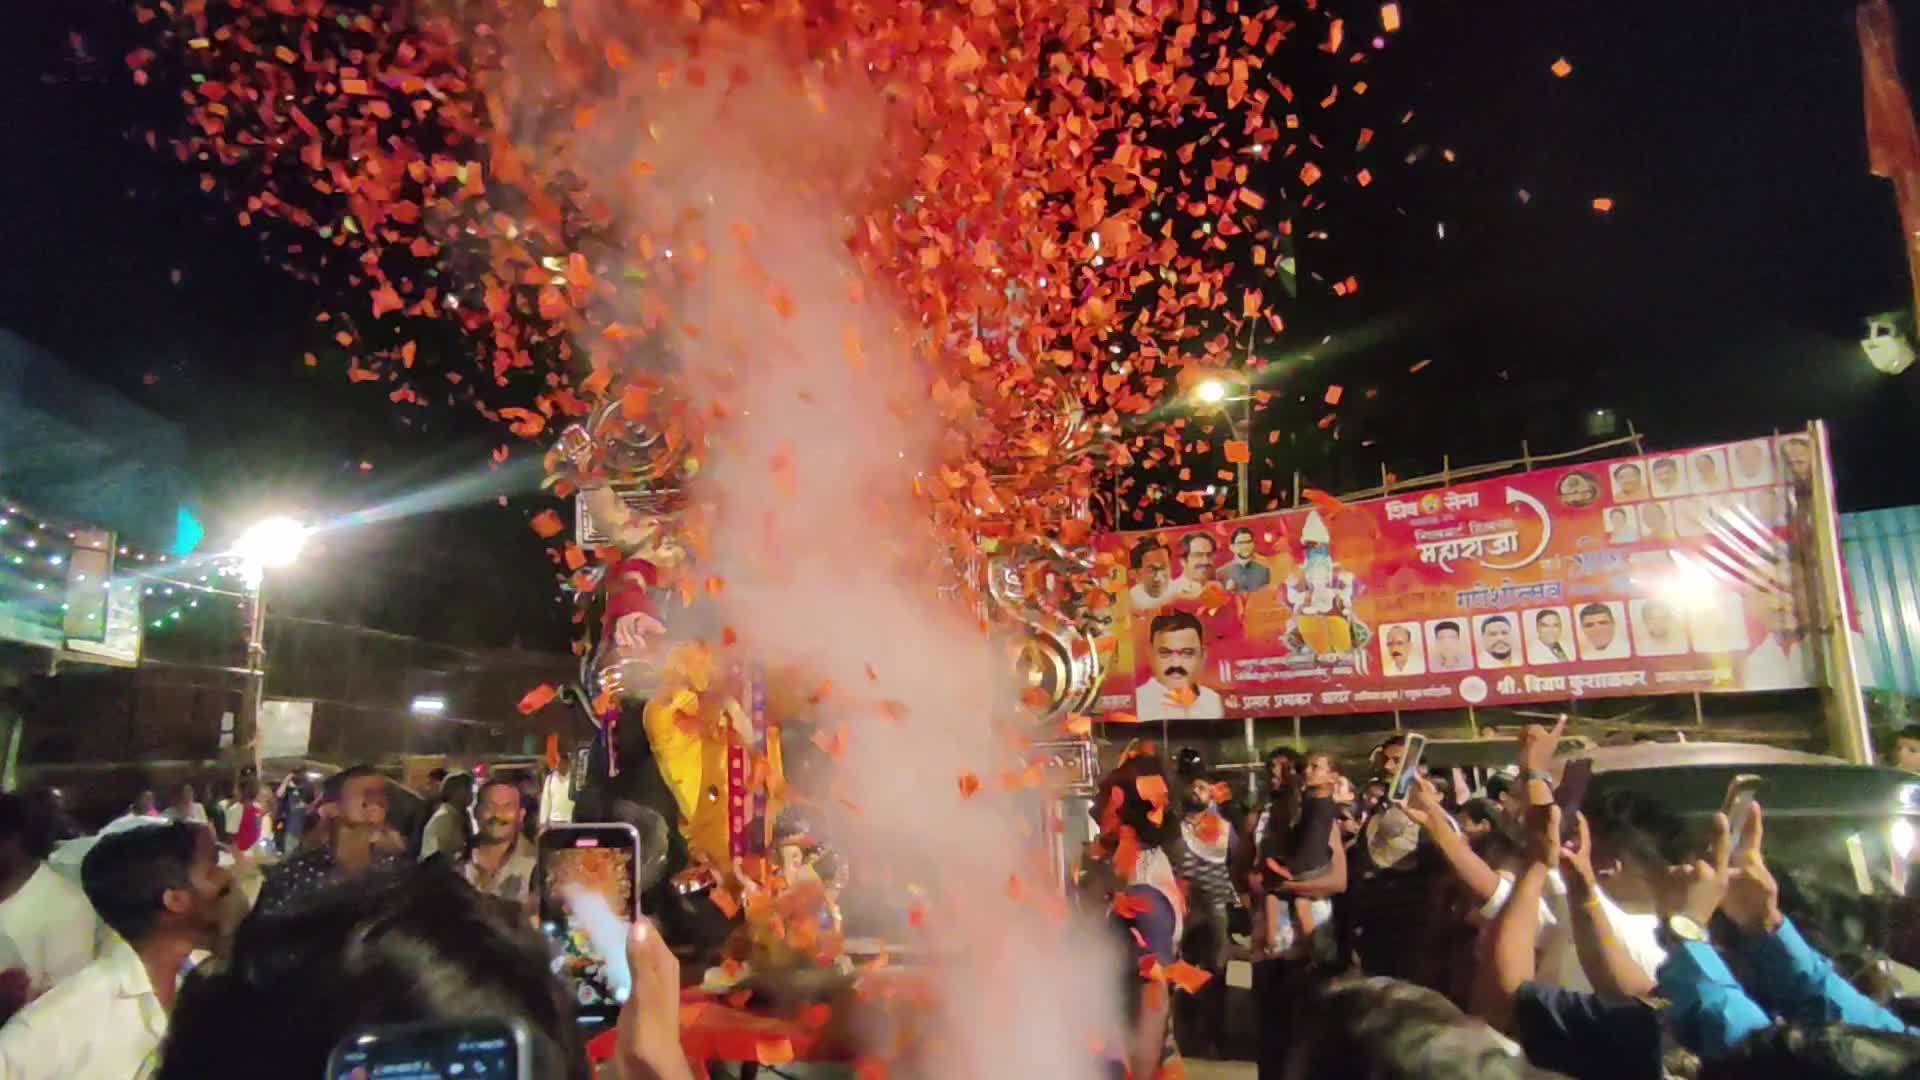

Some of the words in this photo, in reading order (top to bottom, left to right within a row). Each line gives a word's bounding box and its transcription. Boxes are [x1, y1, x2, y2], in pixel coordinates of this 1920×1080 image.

[1385, 500, 1419, 520] शिव
[1444, 491, 1479, 510] सेना
[1415, 531, 1518, 573] महाराजा
